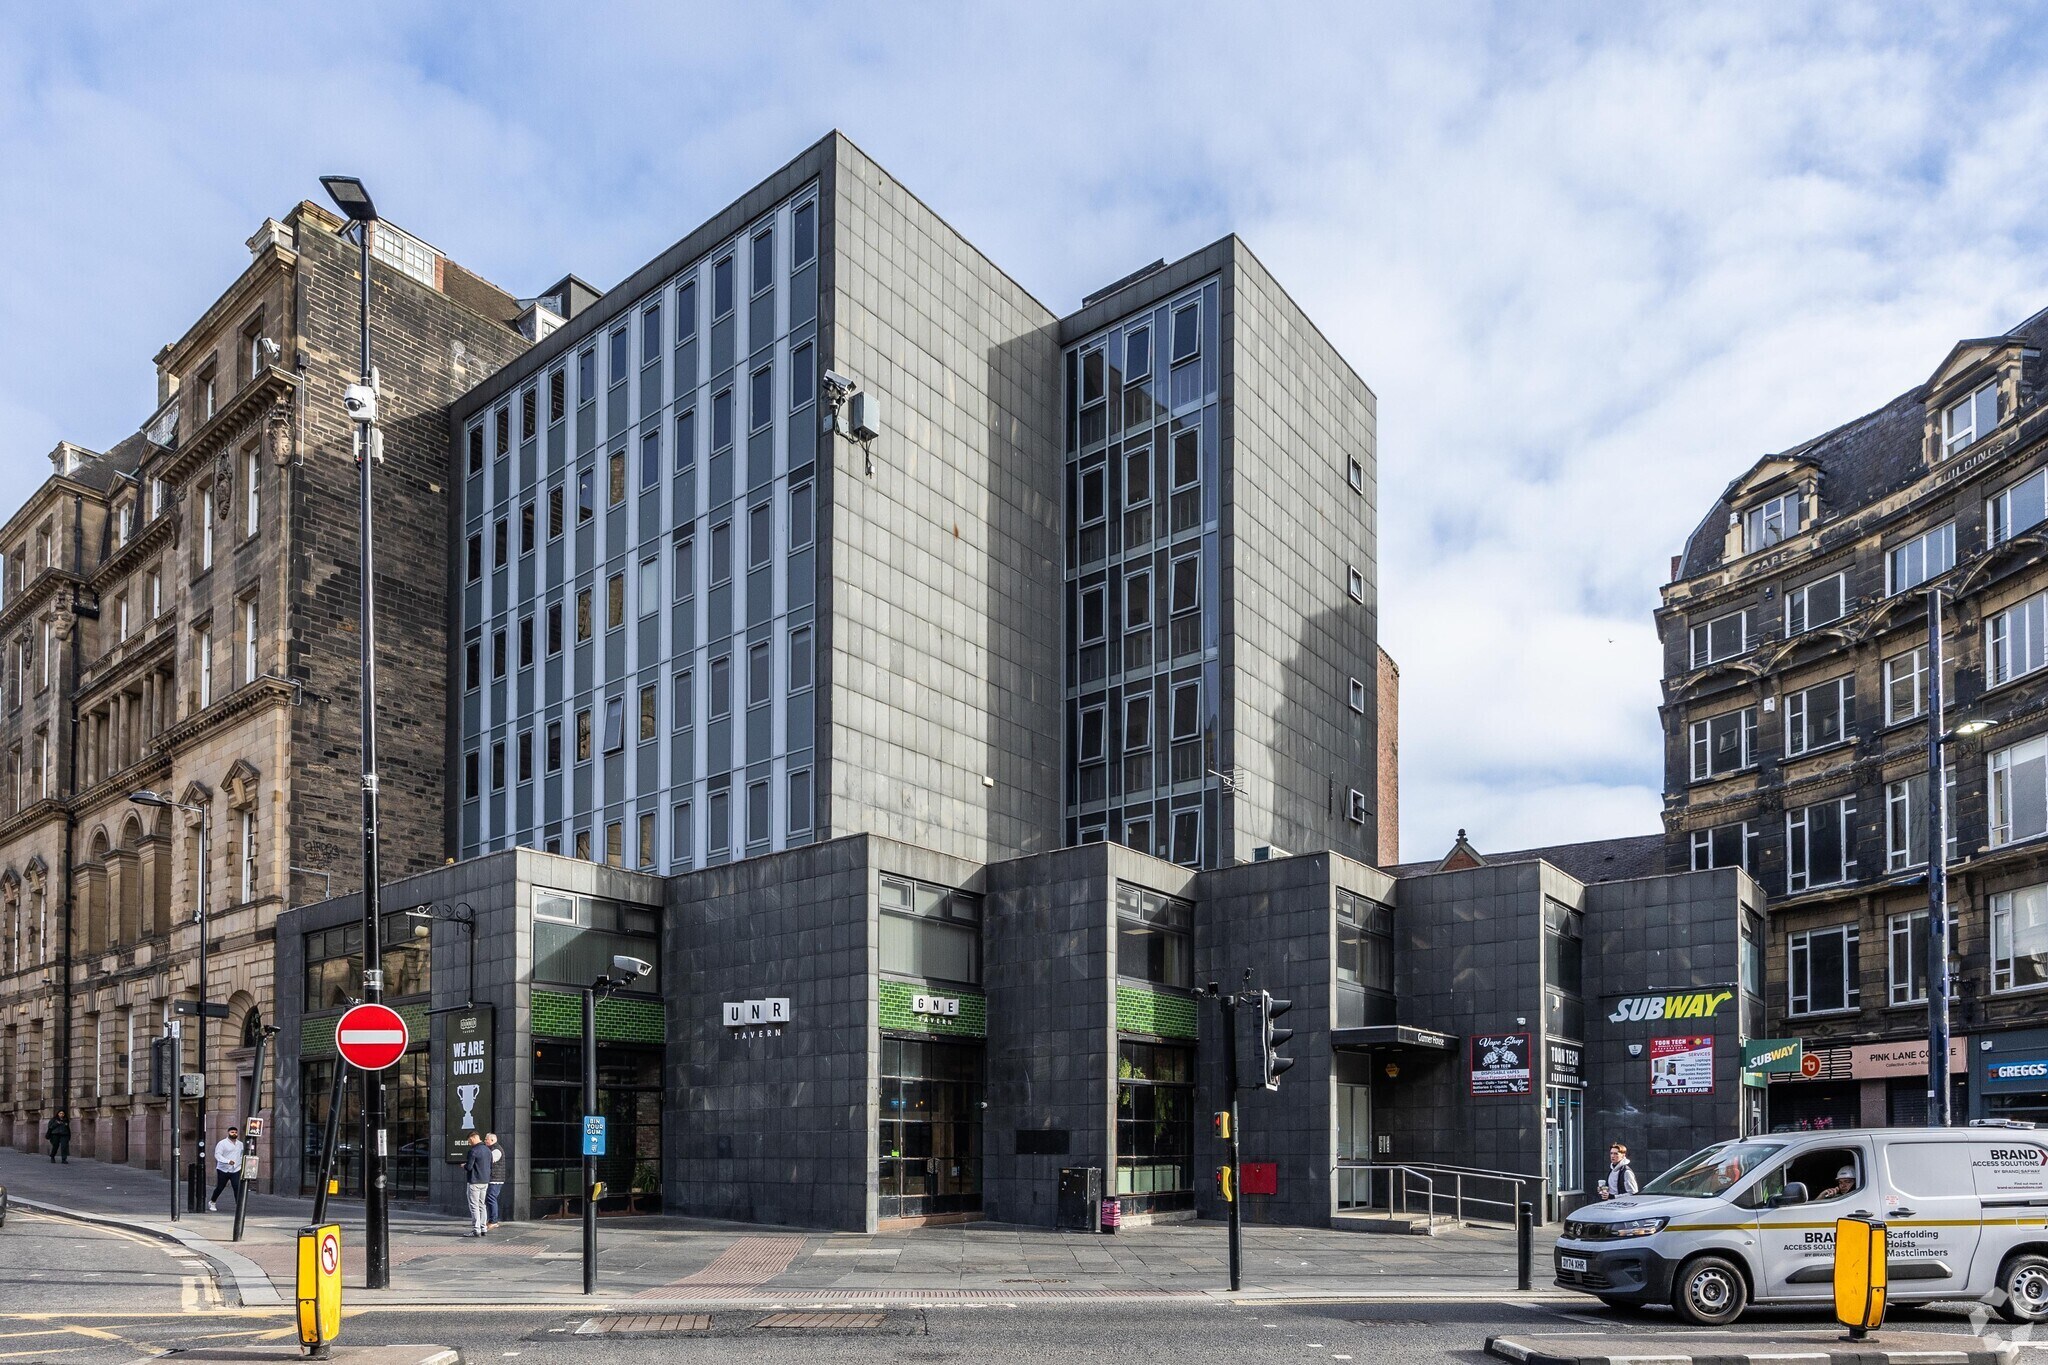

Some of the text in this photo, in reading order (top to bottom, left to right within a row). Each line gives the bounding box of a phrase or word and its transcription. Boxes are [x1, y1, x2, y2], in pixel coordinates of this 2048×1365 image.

[1608, 990, 1733, 1024] SUBWAY
[918, 1015, 953, 1026] TAVERN
[734, 1028, 782, 1040] TAVERN
[1478, 1035, 1524, 1048] Vape Shop
[453, 1040, 485, 1058] WE ARE
[1749, 1042, 1798, 1069] SUBWAY
[1565, 1049, 1579, 1066] TECH
[1869, 1052, 1890, 1062] PINK
[1892, 1050, 1917, 1061] LANE
[453, 1058, 484, 1076] UNITED
[1998, 1063, 2048, 1078] GREGGS
[1990, 1149, 2038, 1160] BRAND
[1886, 1230, 1939, 1240] Scaffolding
[1886, 1248, 1949, 1257] Mastclimbers
